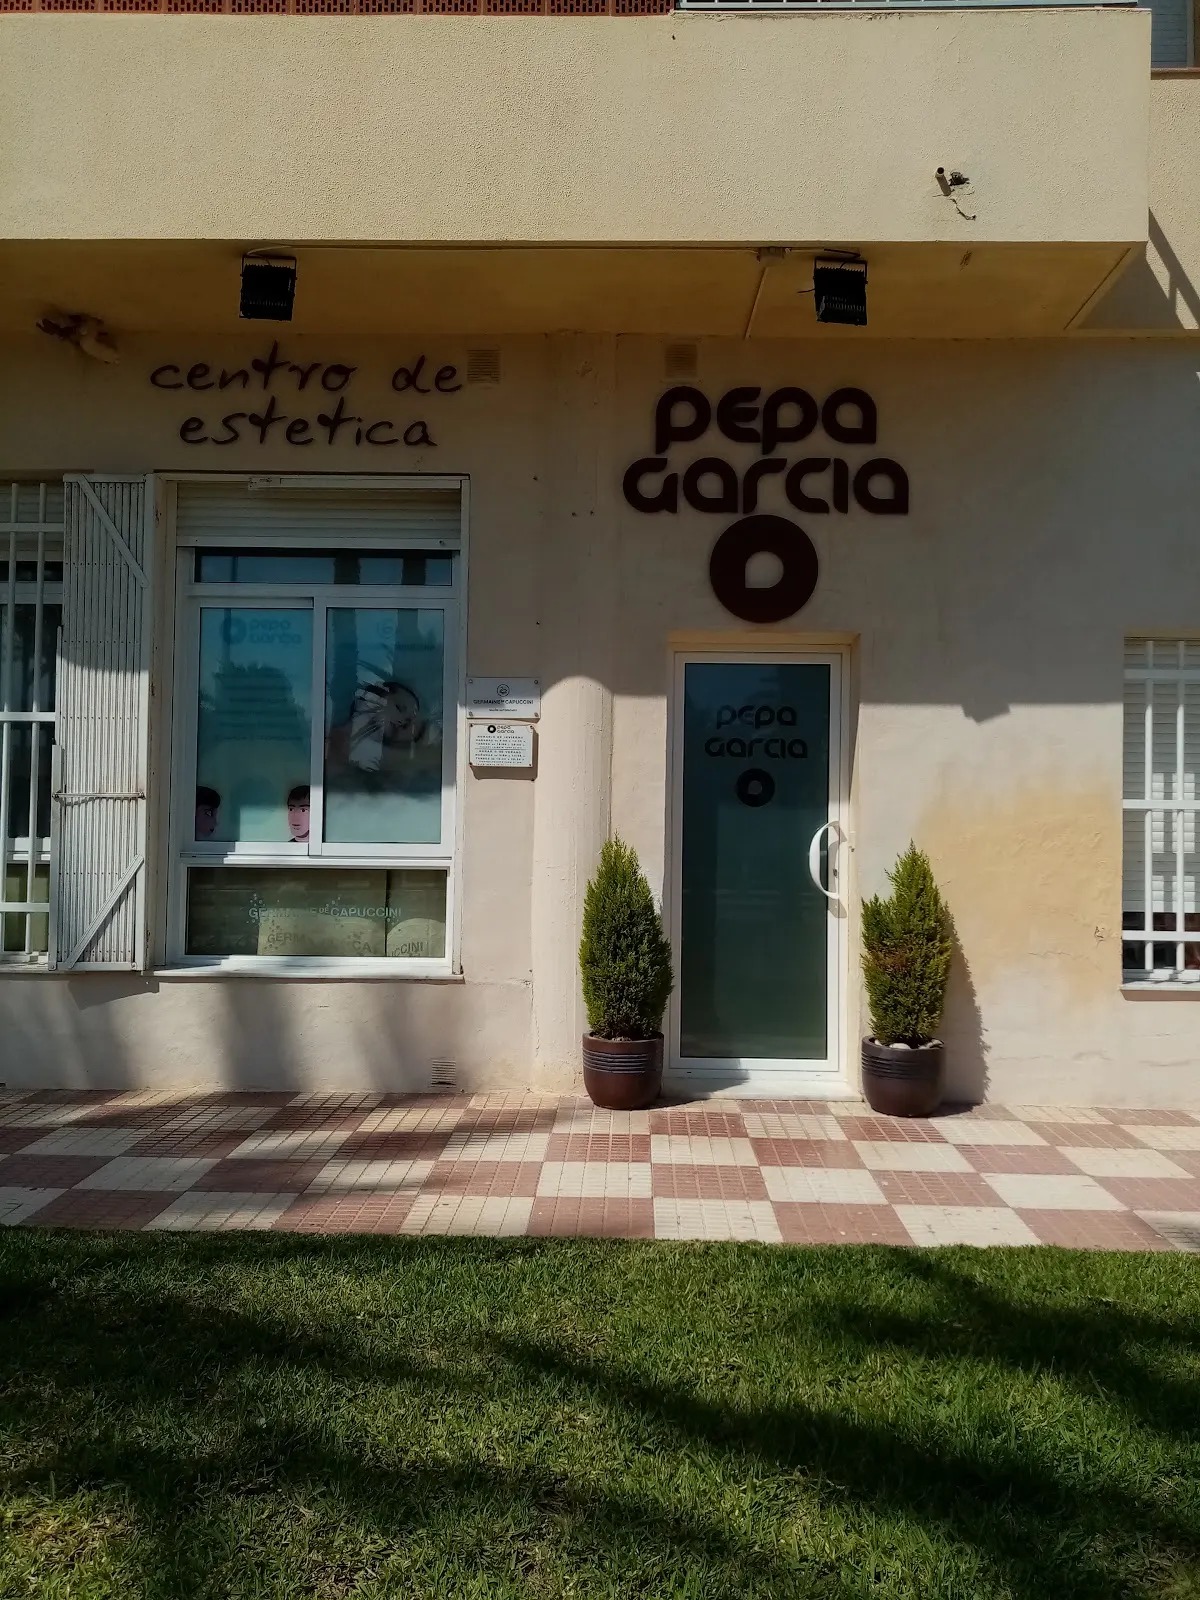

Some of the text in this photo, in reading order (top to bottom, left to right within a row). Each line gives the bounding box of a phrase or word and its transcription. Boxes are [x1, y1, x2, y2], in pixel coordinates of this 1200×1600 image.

[150, 340, 462, 393] centro de
[179, 395, 438, 447] estetica
[330, 907, 401, 917] CAPUCCINI
